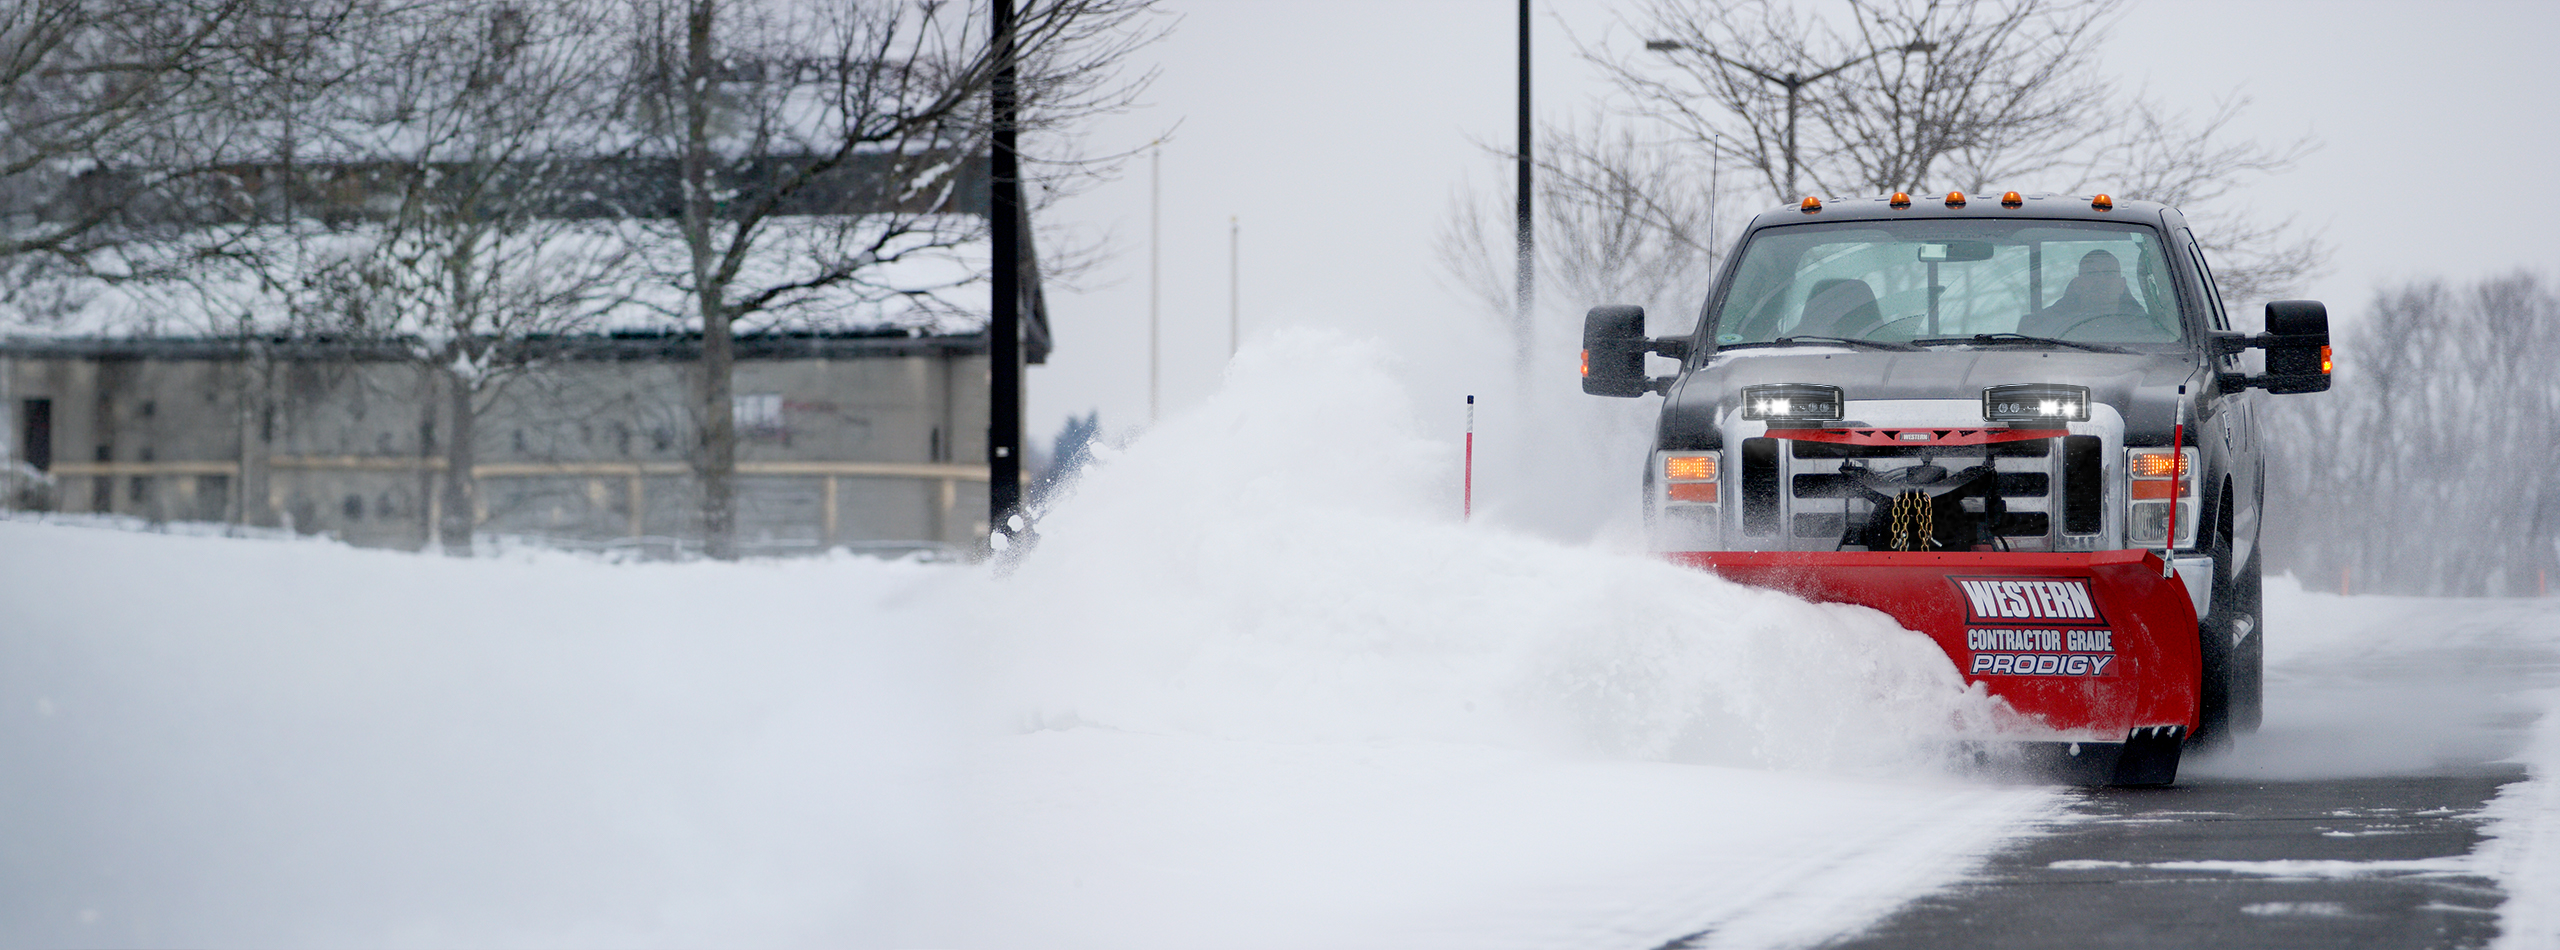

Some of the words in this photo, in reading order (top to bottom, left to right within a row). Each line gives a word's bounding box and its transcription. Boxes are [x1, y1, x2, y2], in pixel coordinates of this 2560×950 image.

[1960, 580, 2096, 618] WESTERN
[1967, 628, 2062, 651] CONTRACTOR
[2066, 629, 2113, 652] GRADE
[1970, 653, 2116, 676] PRODIGY
